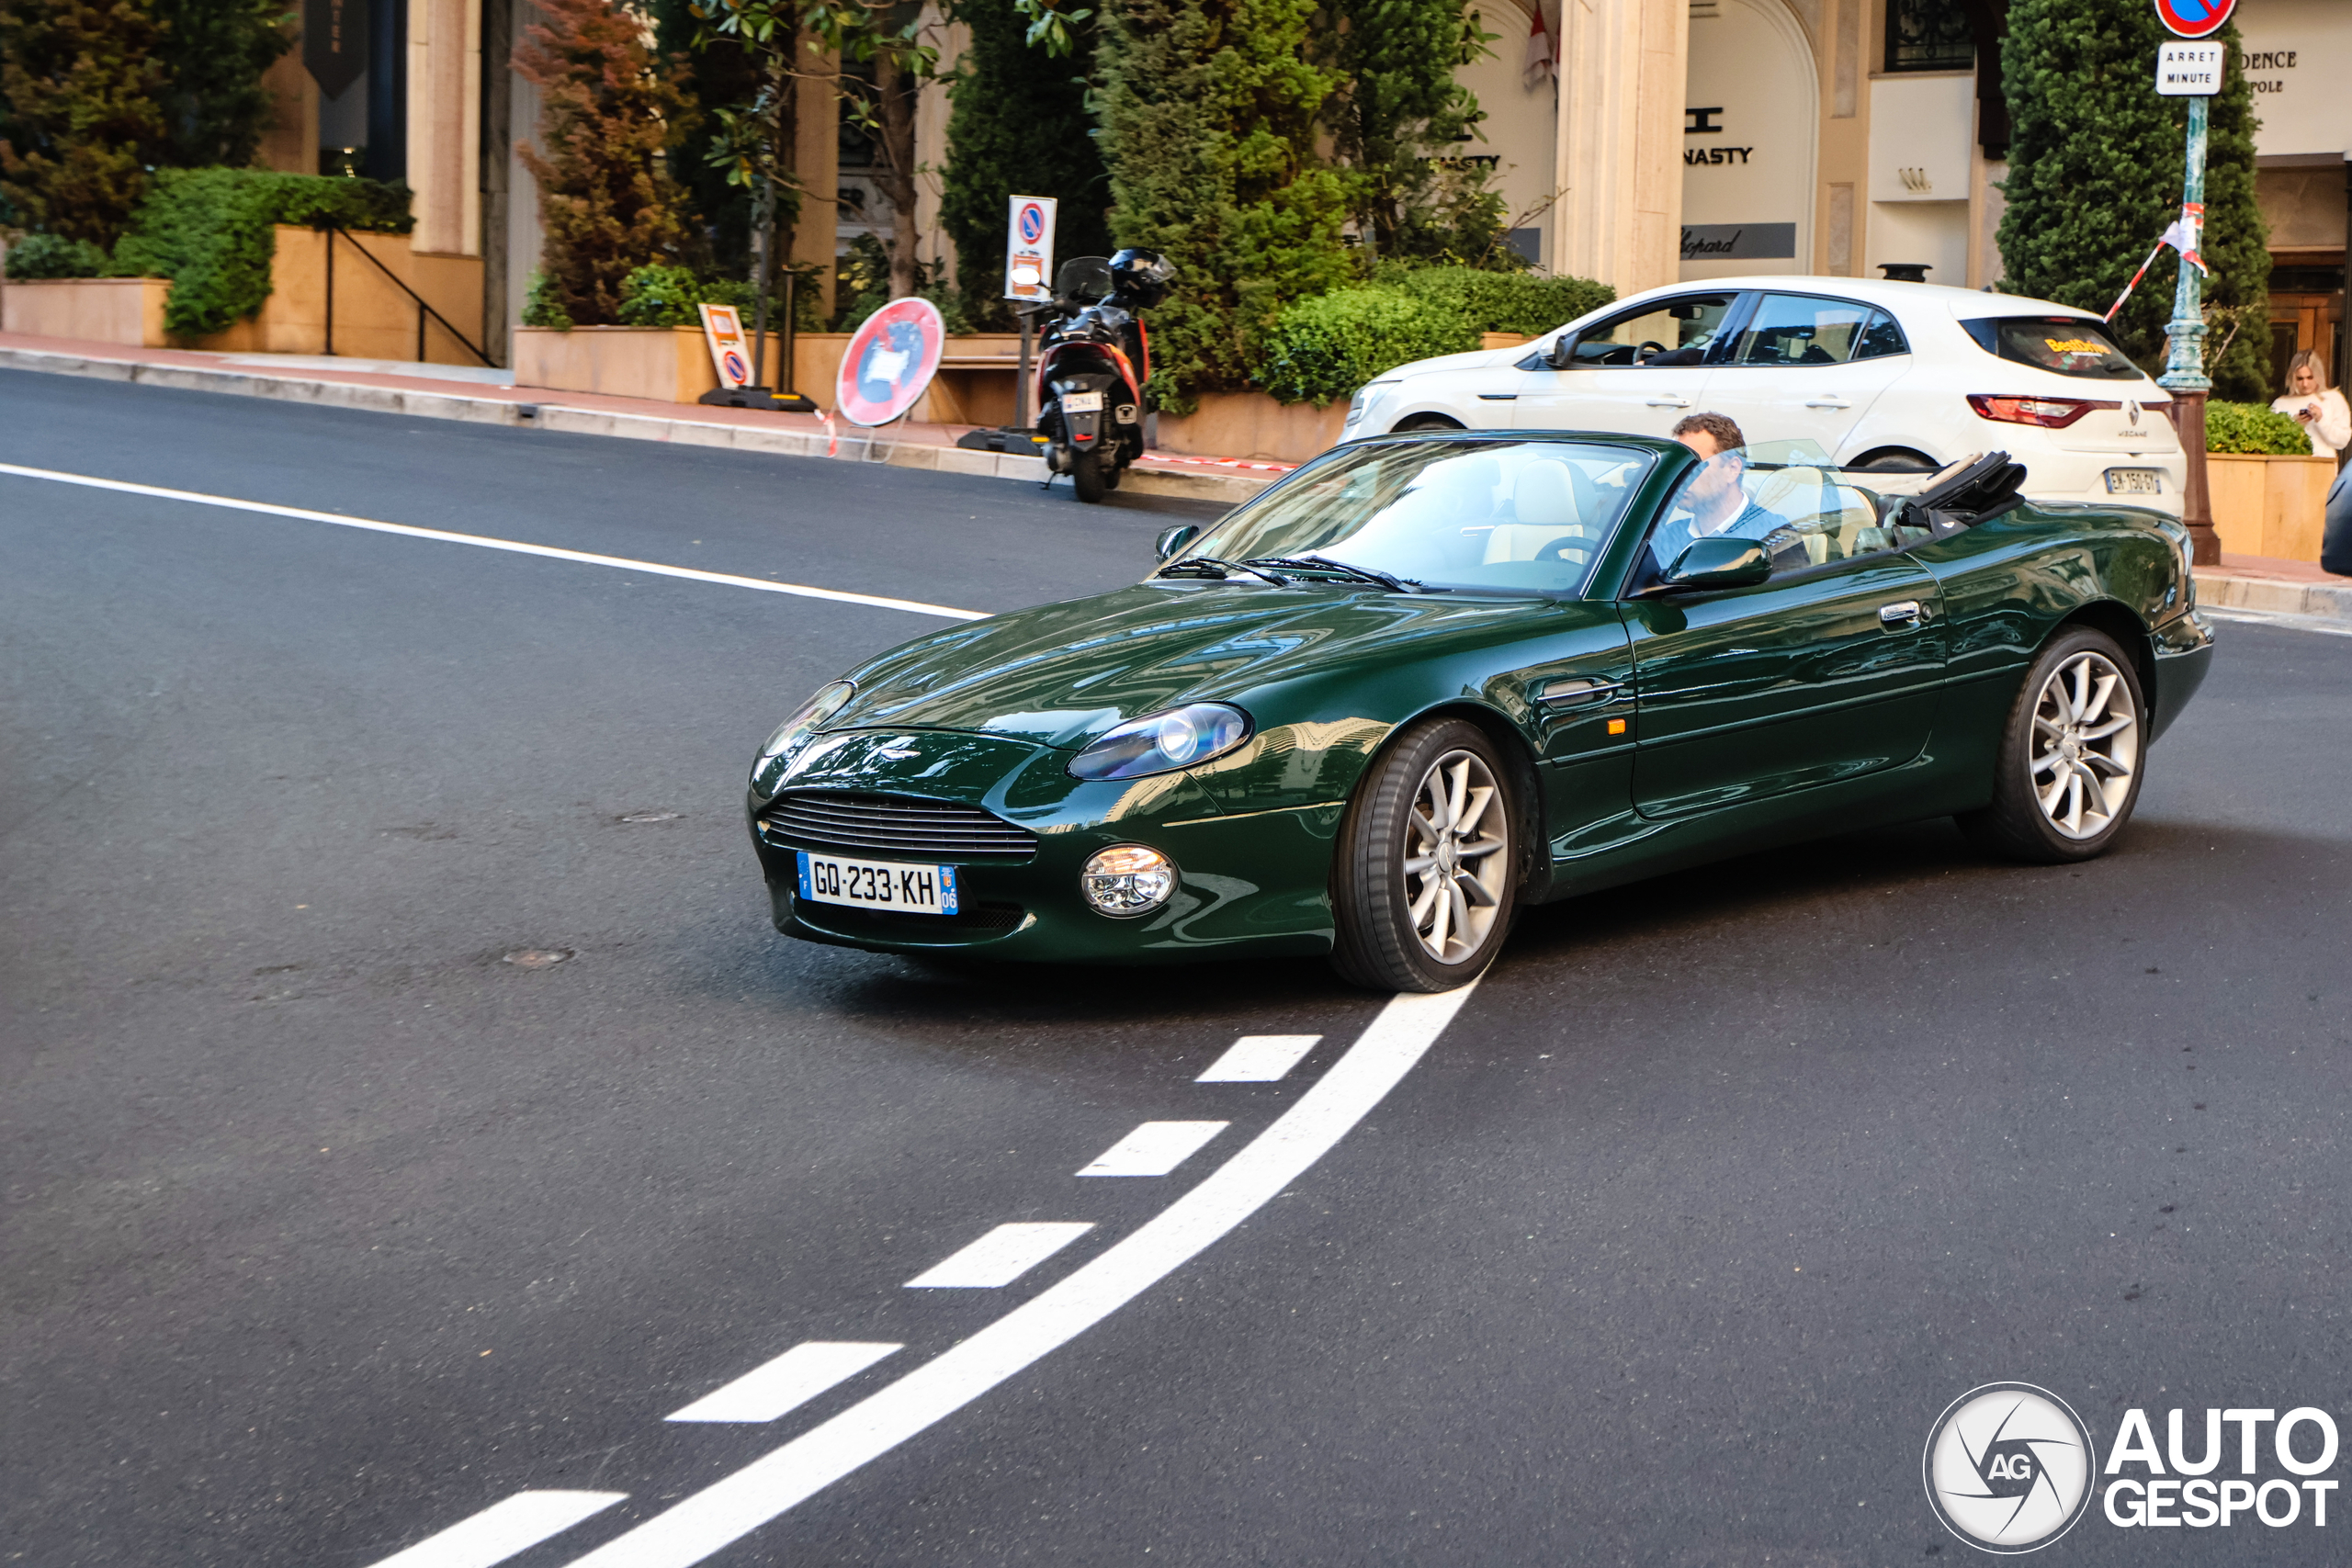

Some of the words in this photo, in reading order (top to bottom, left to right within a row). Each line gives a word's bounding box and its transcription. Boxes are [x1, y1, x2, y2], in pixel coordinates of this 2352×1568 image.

[2166, 51, 2215, 62] ARRET
[2167, 73, 2211, 84] MINUTE
[814, 861, 935, 907] GQ-233-KH
[942, 891, 957, 909] 06
